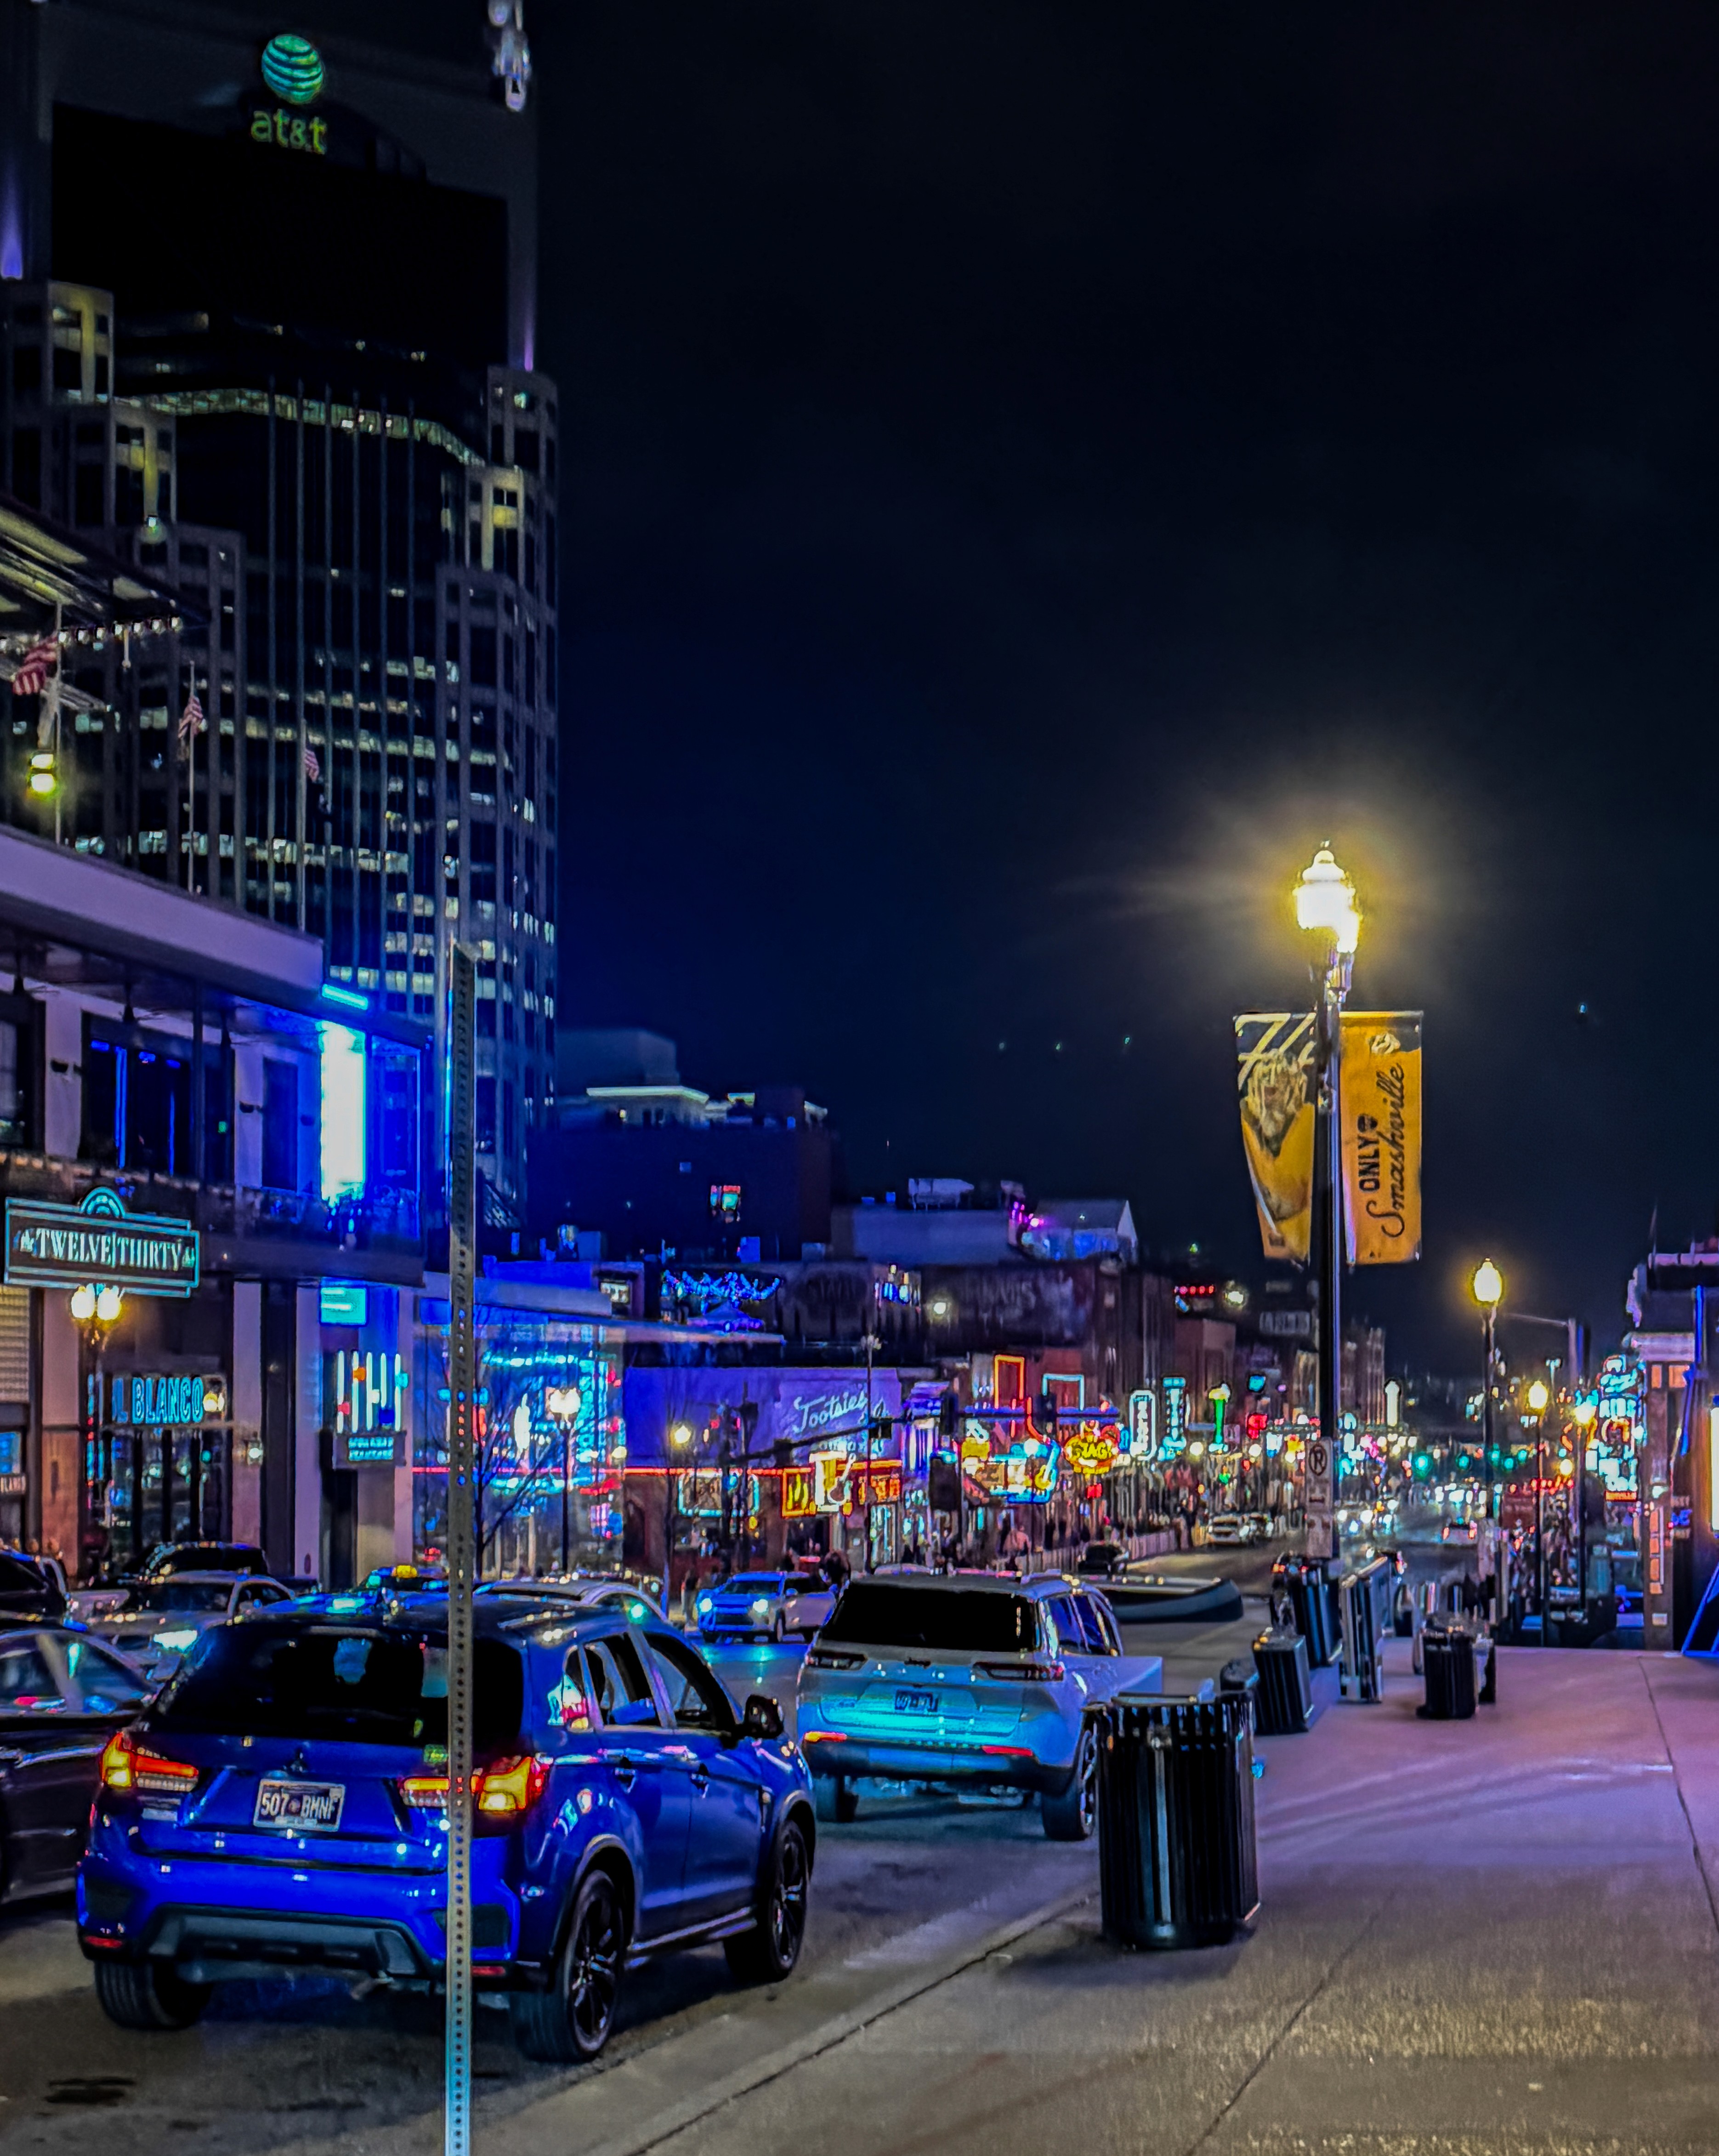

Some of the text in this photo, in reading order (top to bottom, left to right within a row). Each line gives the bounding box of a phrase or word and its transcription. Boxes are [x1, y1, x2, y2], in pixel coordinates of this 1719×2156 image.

[251, 108, 327, 154] at&t
[1357, 1136, 1380, 1191] ONLY
[1366, 1062, 1405, 1238] Smashville
[131, 1377, 204, 1424] BLANCO
[261, 1792, 289, 1816] 507
